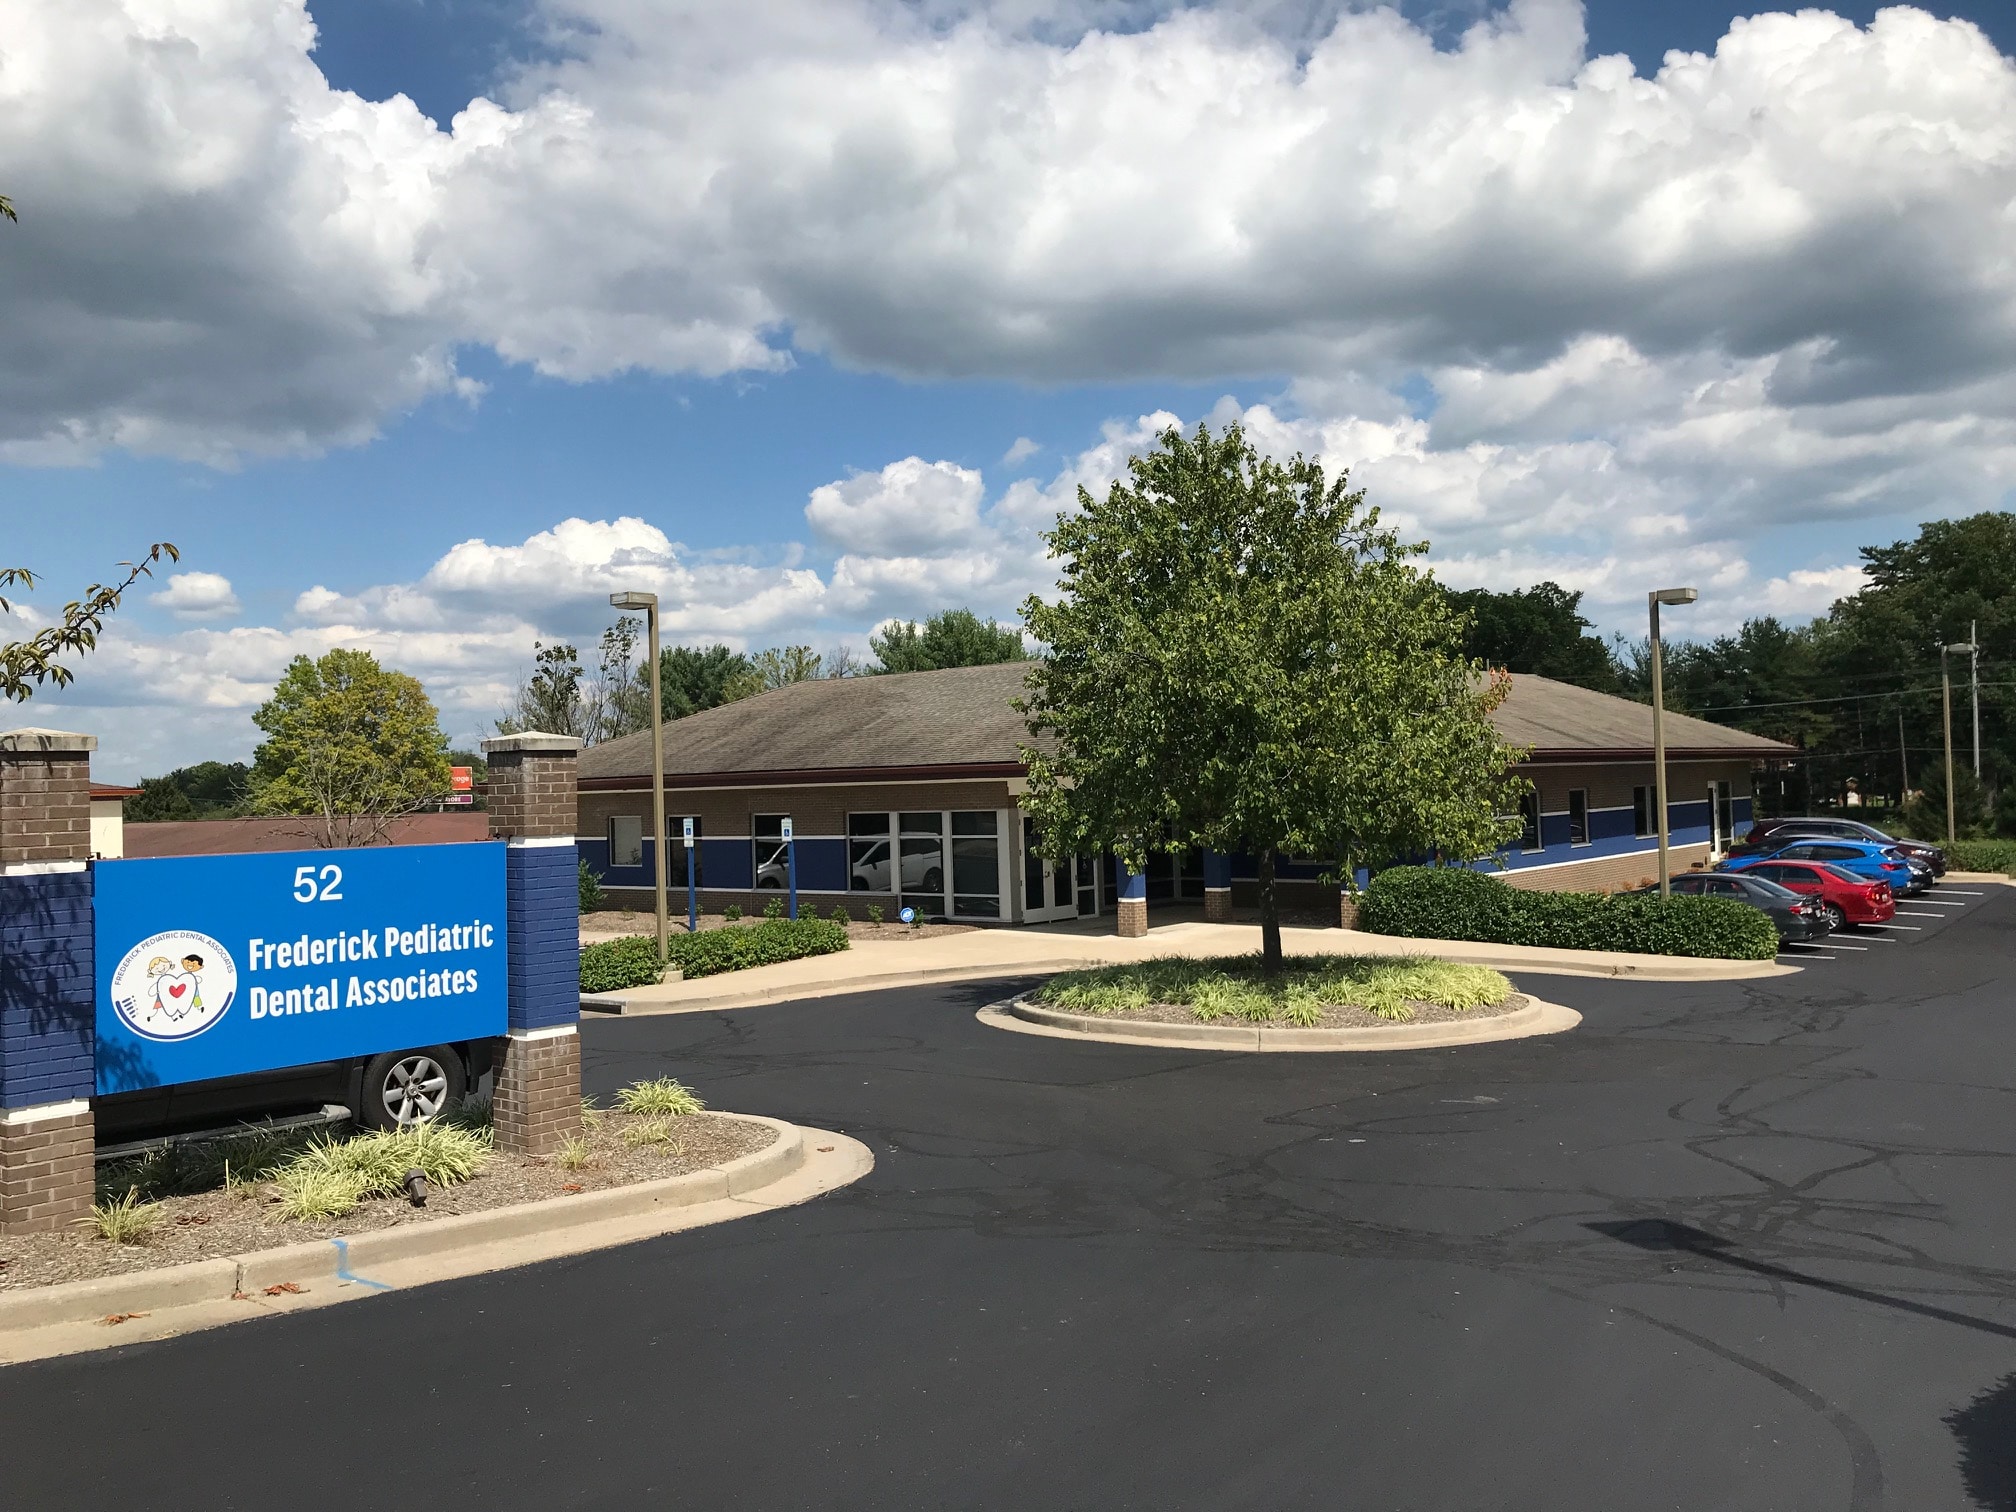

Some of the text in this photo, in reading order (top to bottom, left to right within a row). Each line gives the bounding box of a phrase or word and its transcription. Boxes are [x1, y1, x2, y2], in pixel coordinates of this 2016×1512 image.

[293, 864, 344, 903] 52
[114, 932, 234, 986] FREDERICK PEDIATRIC DENTAL ASSOCIATES
[249, 919, 494, 971] Frederick Pediatric
[250, 967, 478, 1020] Dental Associates
